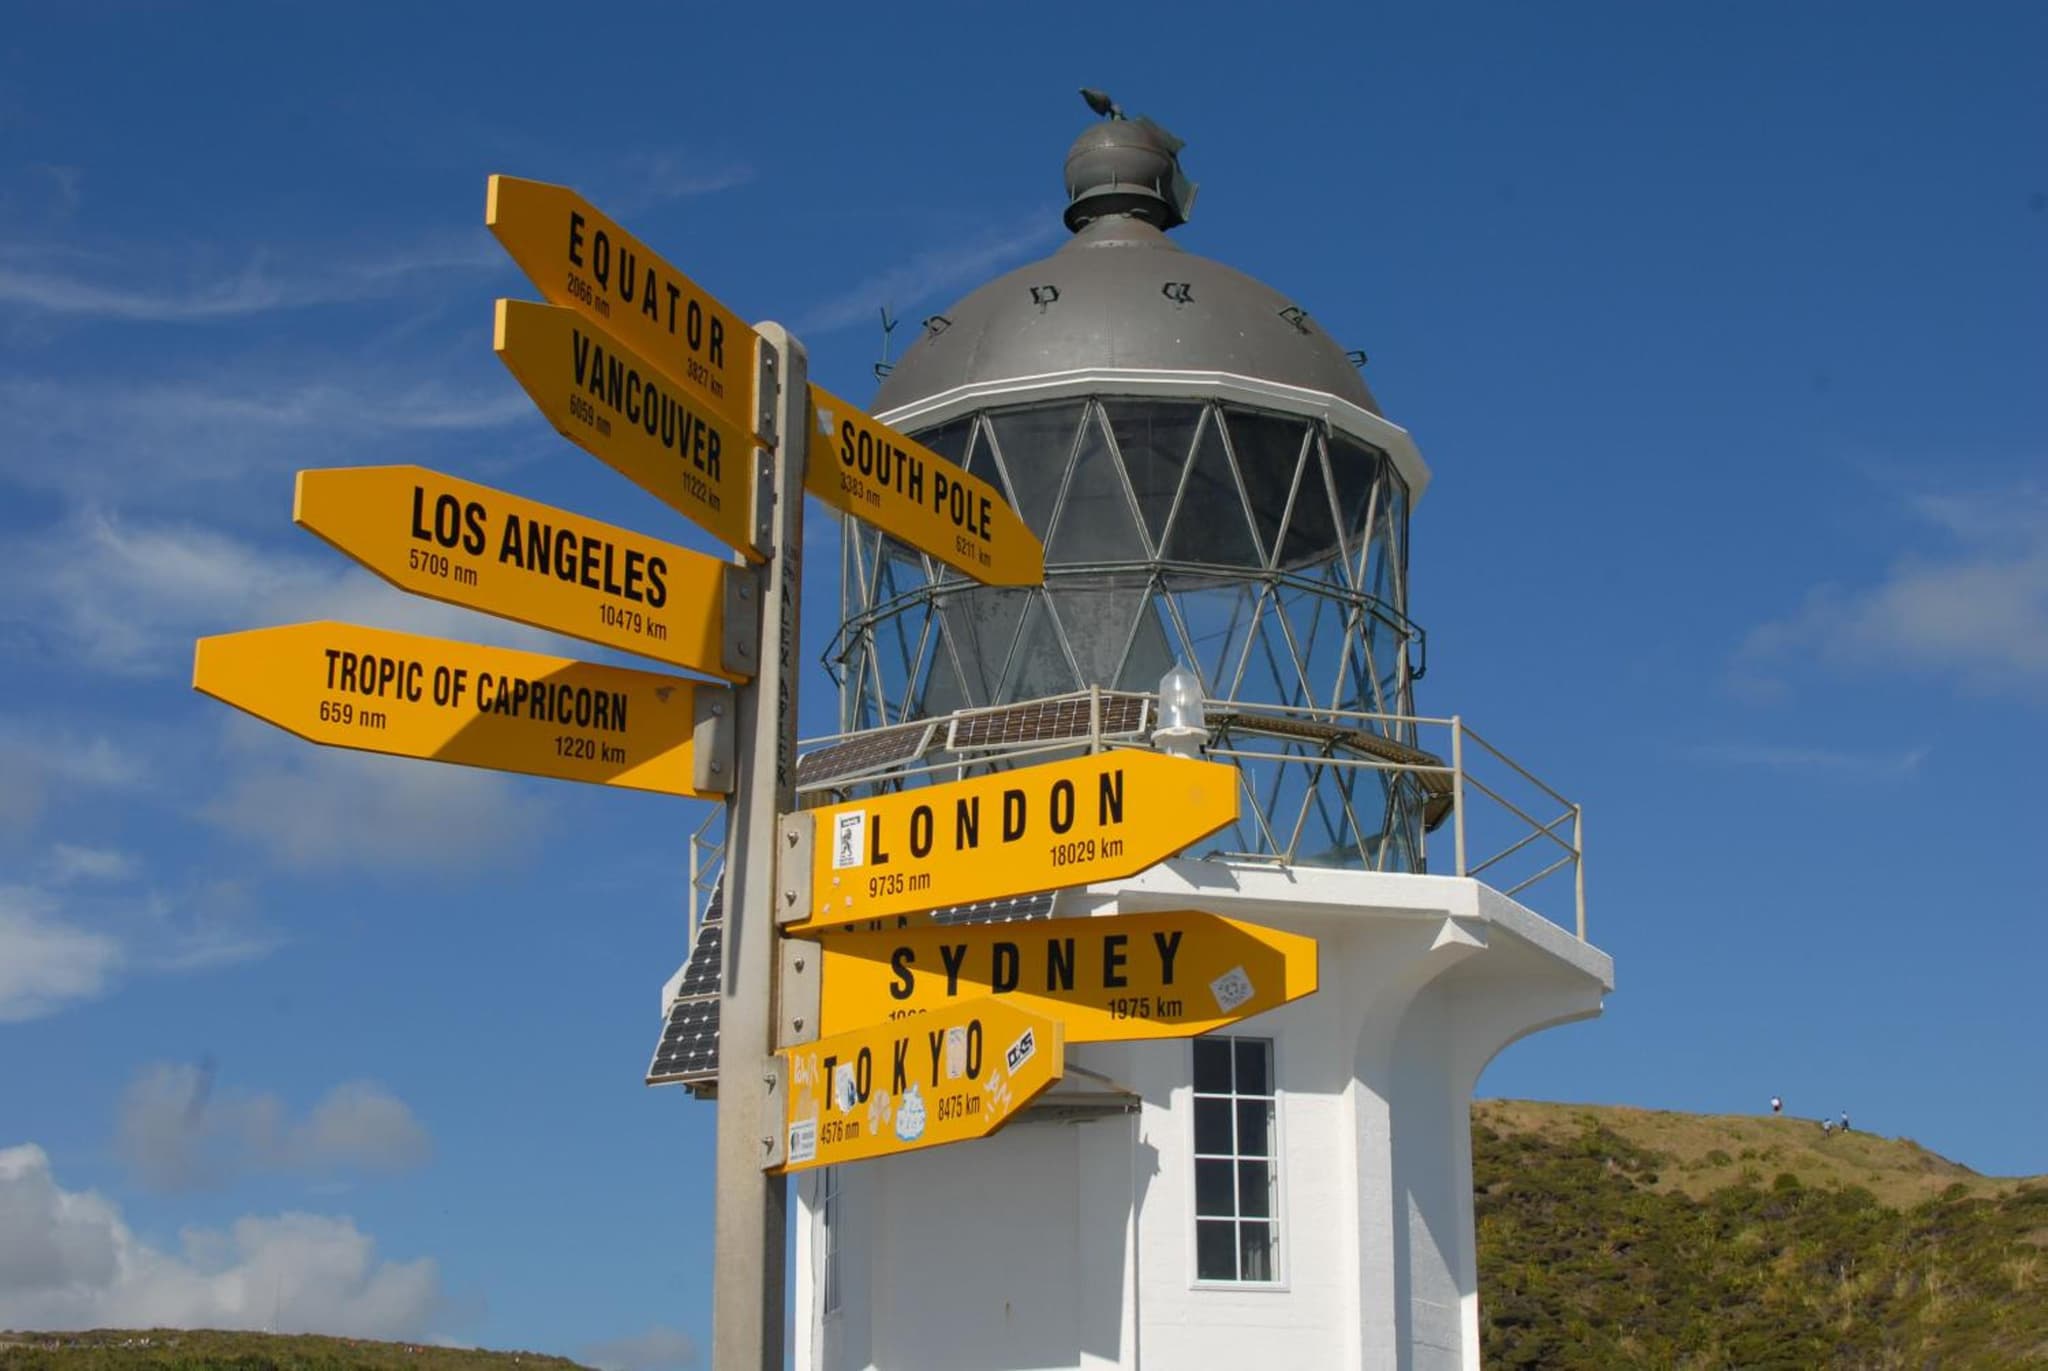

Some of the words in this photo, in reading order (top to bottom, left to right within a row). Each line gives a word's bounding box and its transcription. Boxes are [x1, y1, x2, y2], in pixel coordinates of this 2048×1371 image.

[567, 272, 592, 307] 2066
[594, 294, 610, 318] nm
[568, 211, 724, 369] EQUATOR
[687, 357, 708, 386] 3827
[710, 375, 724, 398] km
[569, 393, 594, 427] 6059
[596, 416, 611, 437] nm
[573, 329, 720, 482] VANCOUVER
[683, 472, 707, 505] 11222
[708, 491, 720, 512] km
[840, 420, 924, 504] SOUTH
[934, 471, 991, 543] POLE
[866, 487, 880, 508] nm
[409, 549, 449, 578] 5709
[454, 563, 478, 586] nm
[411, 486, 487, 556] LOS
[498, 514, 668, 609] ANGELES
[956, 535, 976, 560] 6211
[978, 547, 991, 567] km
[599, 604, 642, 634] 10479
[646, 616, 667, 641] km
[325, 649, 423, 702] TROPIC
[433, 665, 468, 708] OF
[476, 672, 628, 733] CAPRICORN
[319, 700, 353, 724] 659
[359, 708, 386, 730] nm
[554, 736, 595, 760] 1220
[601, 742, 626, 764] km
[870, 769, 1123, 866] LONDON
[1049, 840, 1096, 868] 18029
[1100, 836, 1123, 859] km
[869, 873, 904, 898] 9735
[908, 871, 931, 892] nm
[889, 930, 1184, 1000] SYDNEY
[1108, 998, 1150, 1020] 1975
[1156, 997, 1183, 1017] km
[824, 1019, 983, 1111] TOKYO
[938, 1097, 962, 1121] 8475
[965, 1094, 980, 1114] km
[820, 1120, 843, 1145] 4576
[845, 1121, 860, 1141] nm
